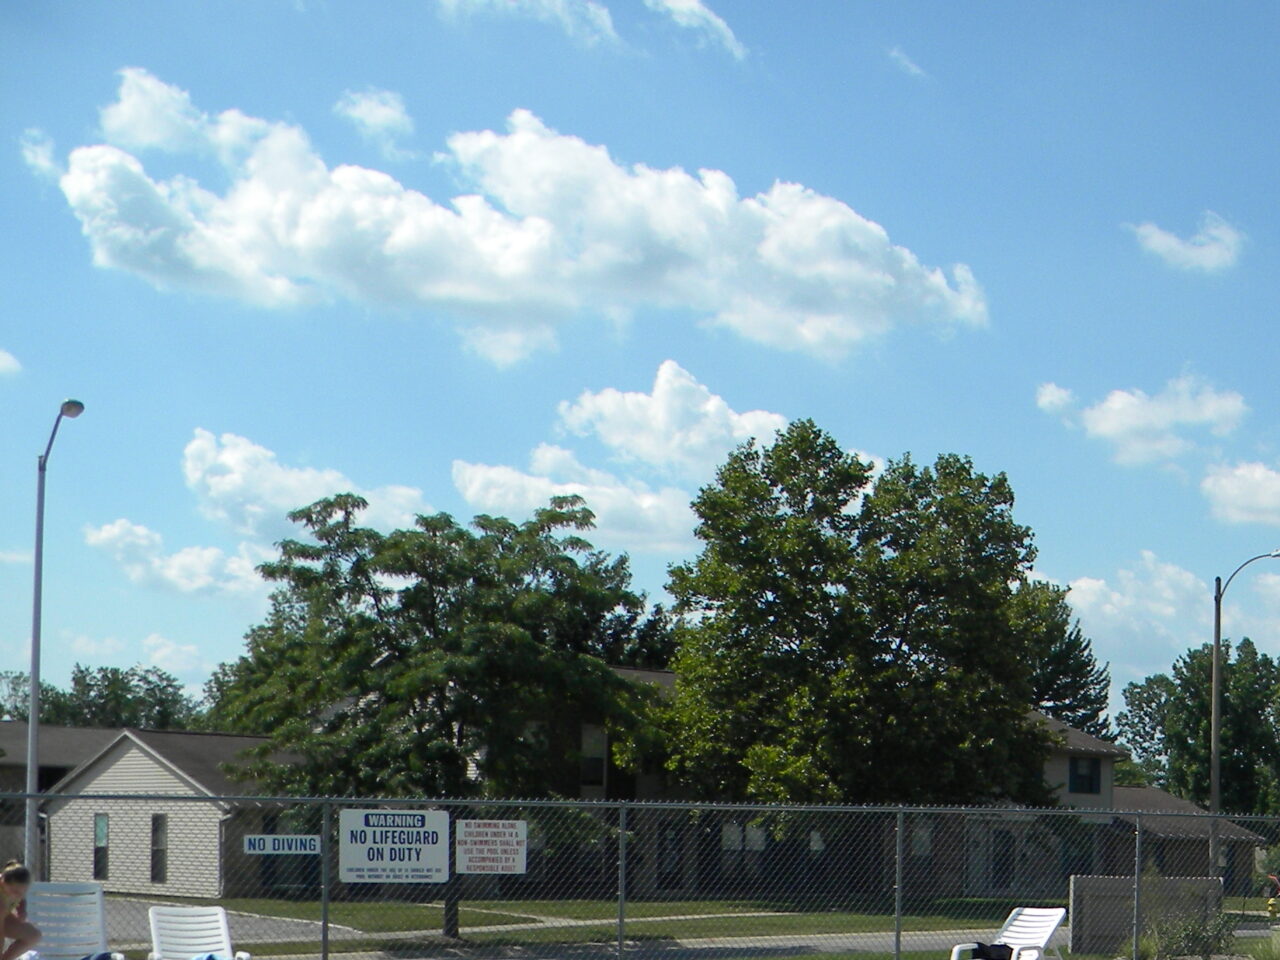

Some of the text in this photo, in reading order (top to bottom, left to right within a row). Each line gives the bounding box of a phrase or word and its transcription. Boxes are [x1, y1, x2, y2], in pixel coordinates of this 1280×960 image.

[367, 814, 423, 827] WARNING
[247, 837, 317, 852] NO DIVING
[349, 830, 439, 845] NO LIFEGUARD
[367, 847, 422, 862] ON DUTY
